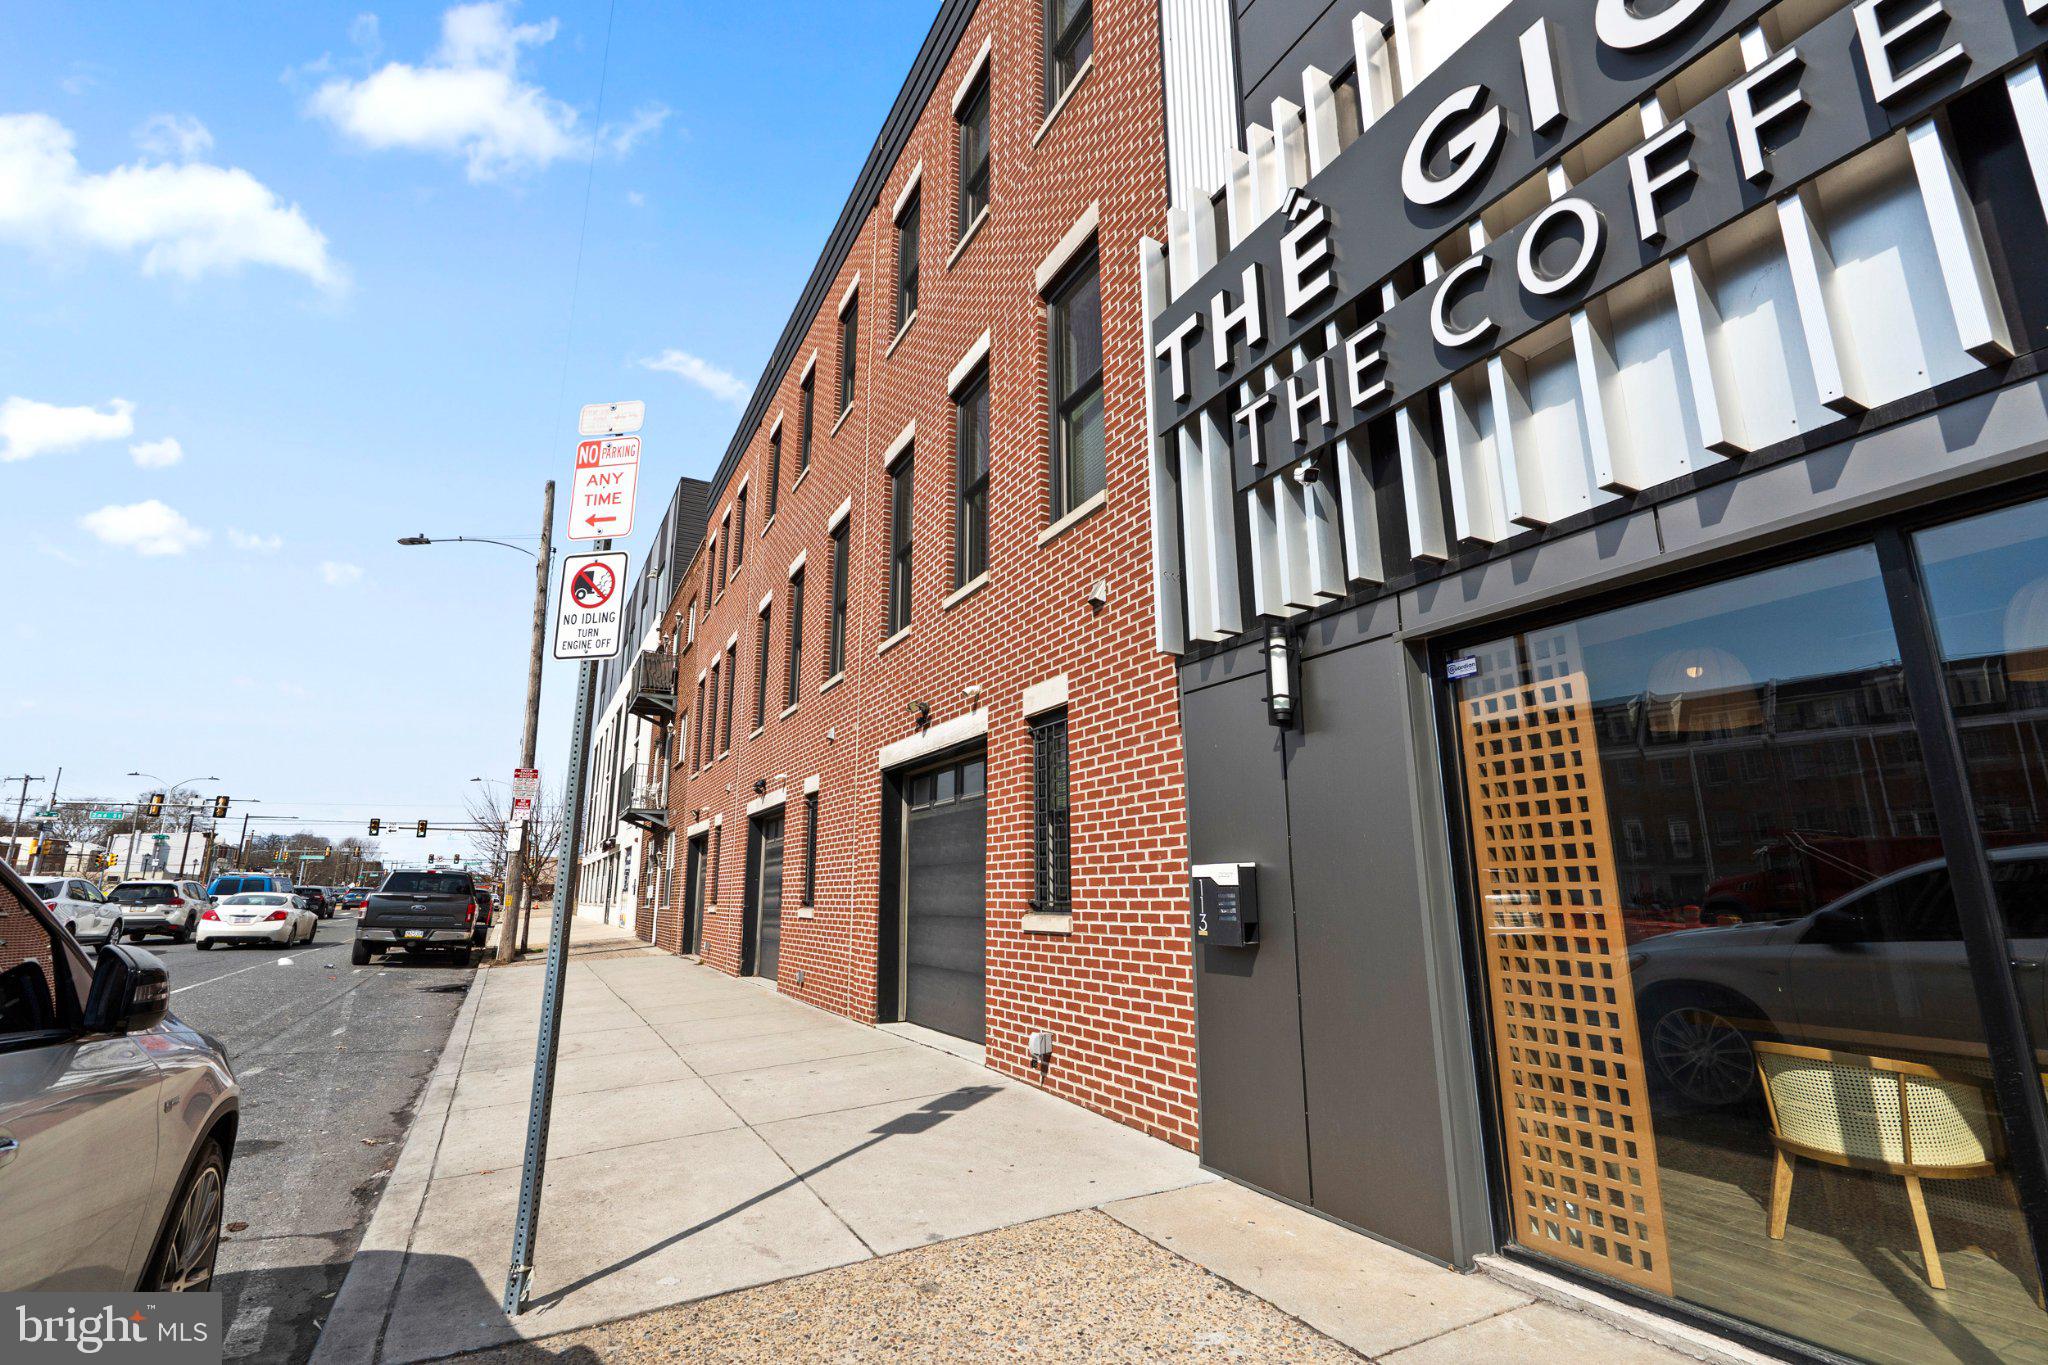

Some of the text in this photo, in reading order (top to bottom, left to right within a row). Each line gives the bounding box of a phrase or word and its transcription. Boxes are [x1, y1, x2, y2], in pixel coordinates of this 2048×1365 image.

[1234, 0, 2048, 467] THE COFFE
[578, 444, 636, 465] NO PARKING
[586, 472, 624, 487] ANY
[584, 492, 622, 506] TIME
[563, 611, 616, 625] NO IDLING
[578, 628, 599, 637] TURN
[562, 639, 611, 650] ENGINE OFF
